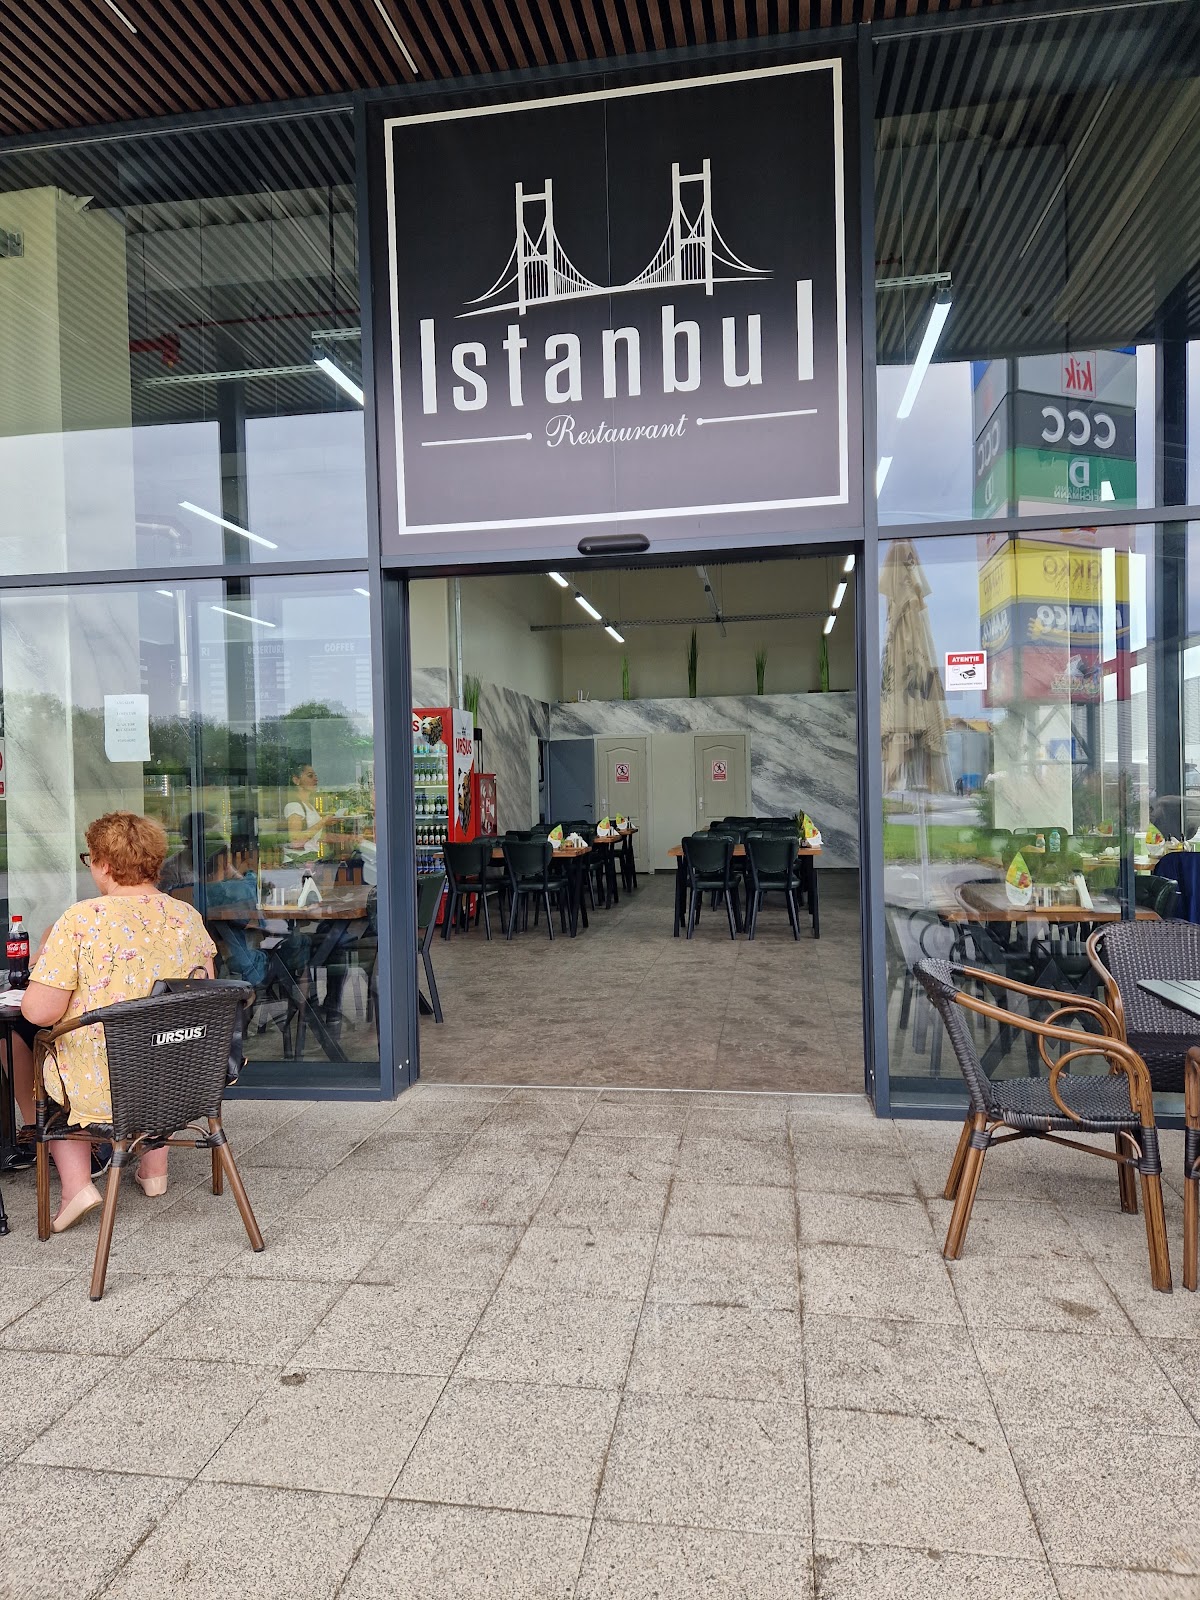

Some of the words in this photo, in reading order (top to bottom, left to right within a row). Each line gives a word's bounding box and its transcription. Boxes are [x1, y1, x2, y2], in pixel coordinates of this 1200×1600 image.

[420, 279, 814, 415] Istanbul
[545, 414, 689, 448] Restaurant
[324, 642, 355, 653] COFFEE
[455, 737, 472, 756] URSUS
[156, 1027, 204, 1045] URSUS
